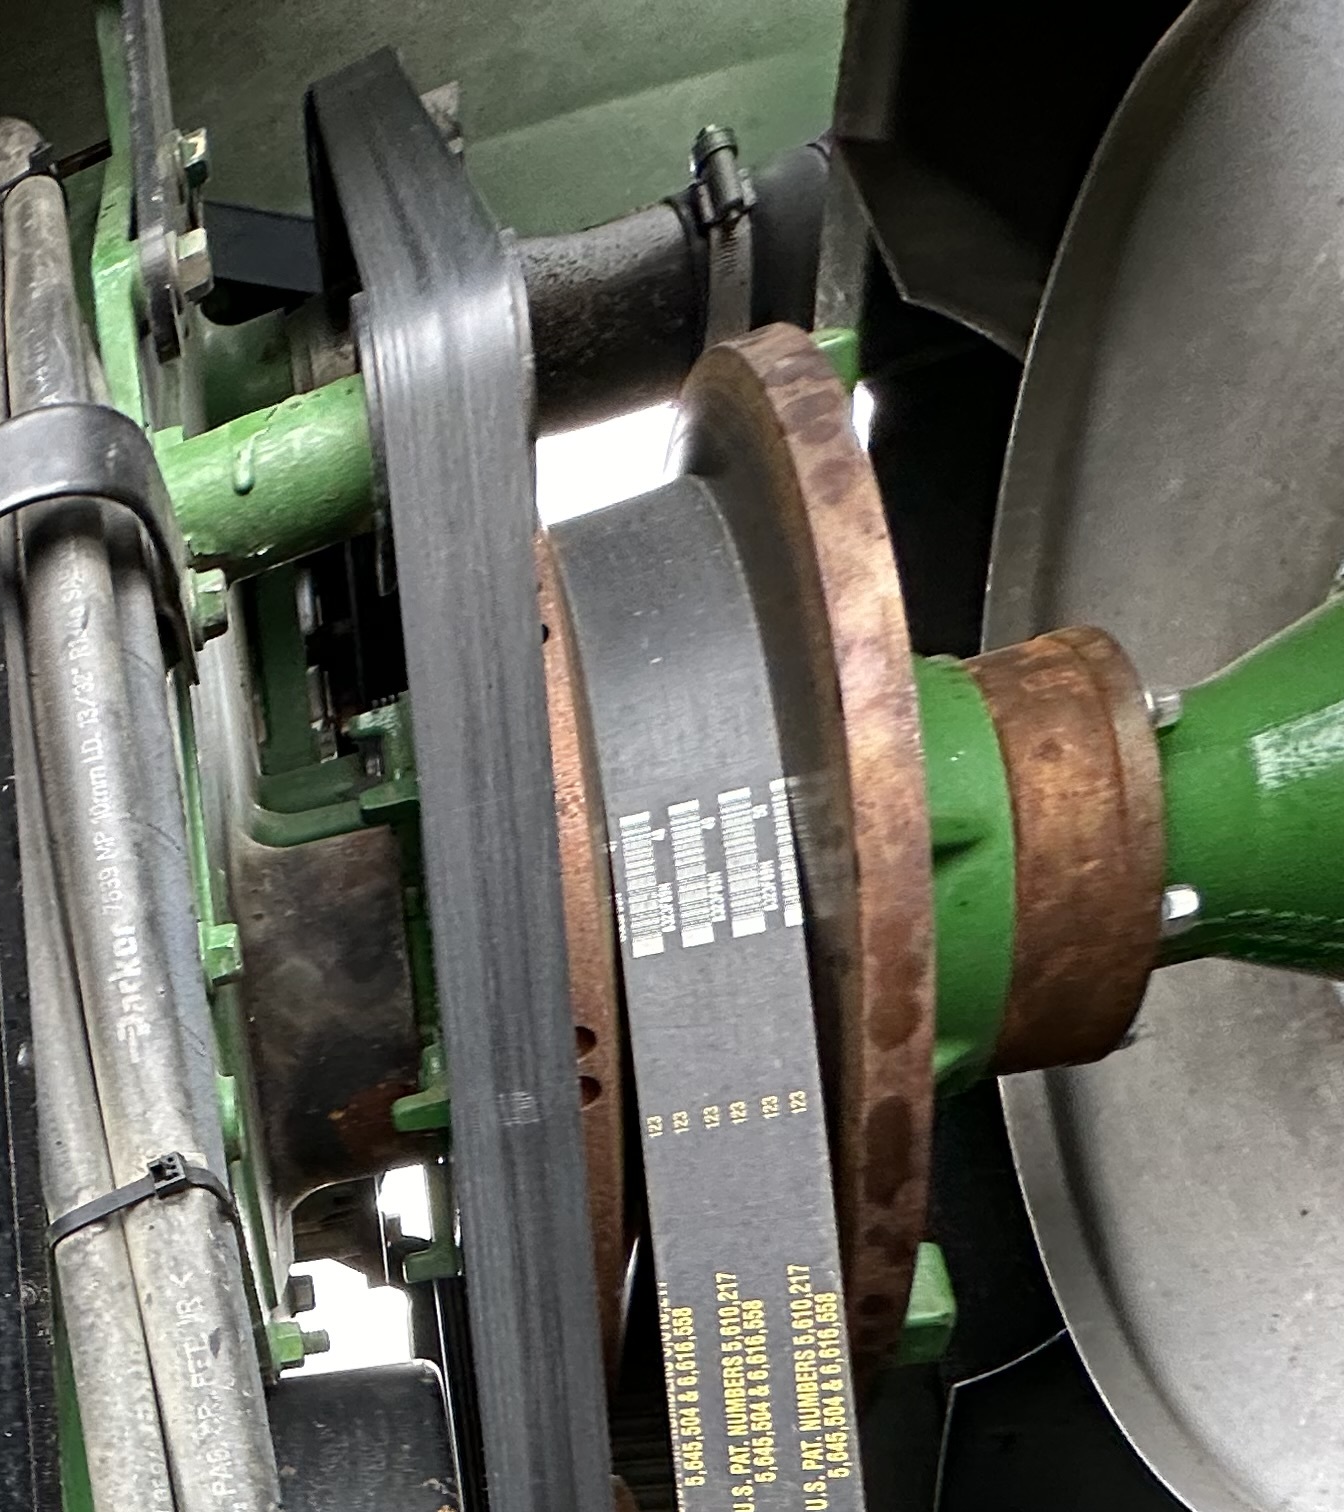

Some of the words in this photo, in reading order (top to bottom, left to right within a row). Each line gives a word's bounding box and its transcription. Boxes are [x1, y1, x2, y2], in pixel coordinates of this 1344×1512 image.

[703, 1106, 720, 1129] 123
[730, 1101, 748, 1124] 123
[761, 1096, 779, 1119] 123
[789, 1091, 808, 1113] 123
[647, 1115, 664, 1138] 123
[673, 1111, 691, 1134] 123
[716, 1273, 744, 1352] 5,610,217
[787, 1264, 817, 1345] 5,610,217
[671, 1306, 700, 1386] 6,616,558
[745, 1299, 771, 1380] 6,616,558
[818, 1292, 844, 1374] 6,616,558
[678, 1391, 699, 1402] &
[721, 1356, 749, 1436] NUMBERS
[749, 1385, 769, 1396] &
[794, 1349, 823, 1431] NUMBERS
[824, 1379, 842, 1391] &
[679, 1407, 706, 1486] 5,645,504
[752, 1402, 778, 1482] 5,645,504
[801, 1436, 824, 1470] PAT.
[825, 1396, 850, 1477] 5,645,504
[728, 1440, 751, 1474] PAT.
[803, 1475, 828, 1510] U.S.
